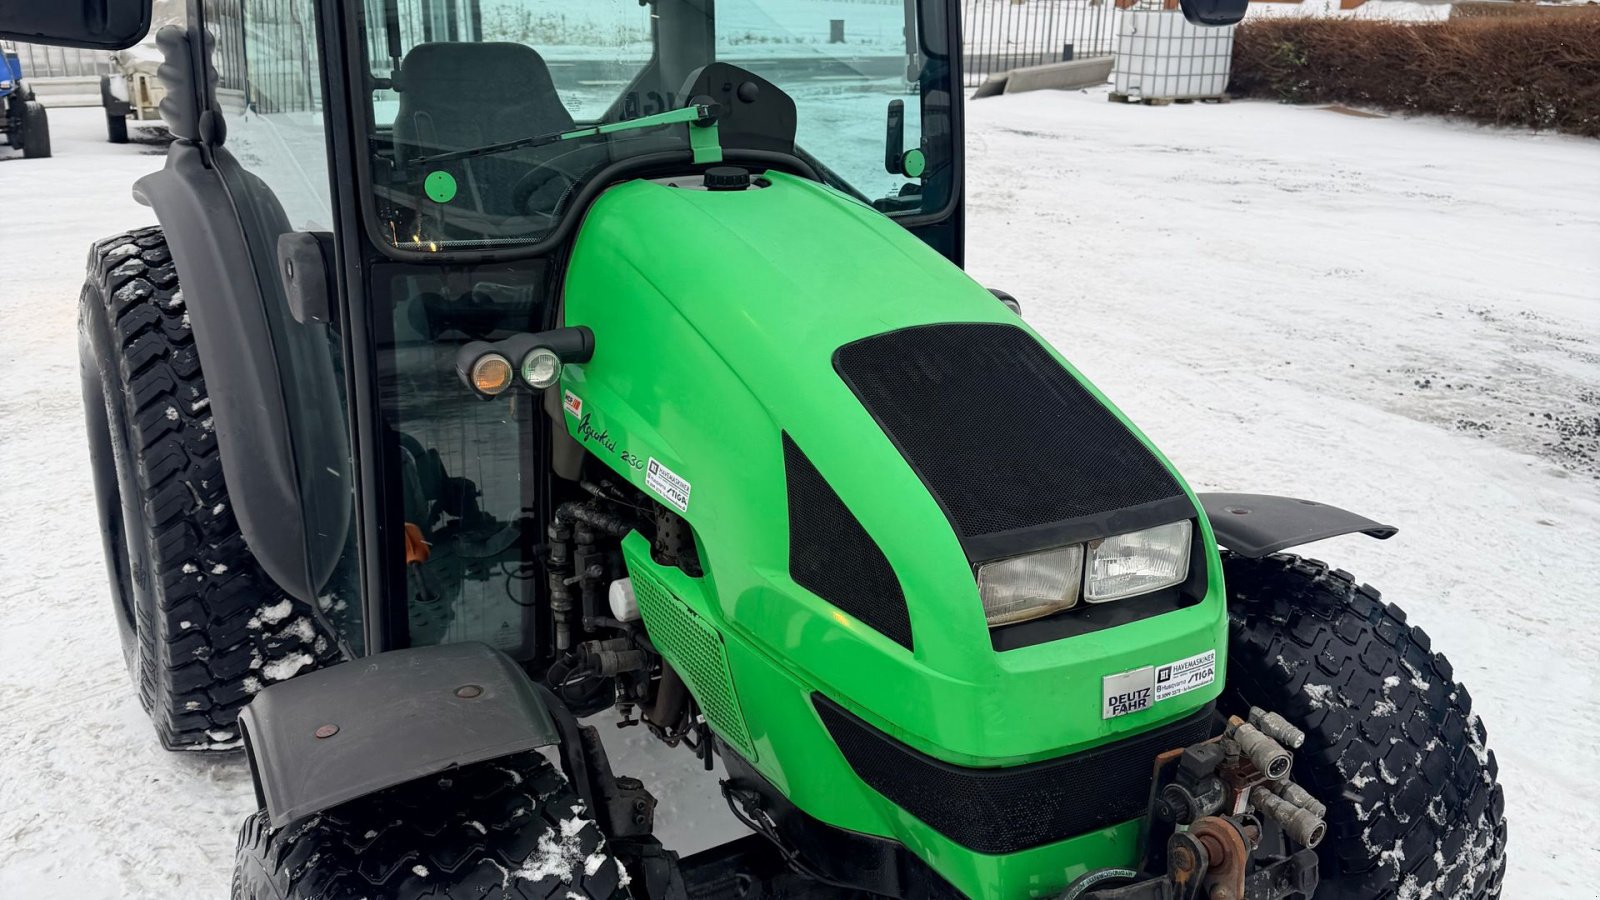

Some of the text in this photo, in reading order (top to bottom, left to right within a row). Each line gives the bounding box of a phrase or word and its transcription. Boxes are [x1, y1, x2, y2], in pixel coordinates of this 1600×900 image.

[620, 450, 644, 470] 230
[1173, 653, 1214, 672] HAVEMASKINER
[1187, 667, 1214, 684] STIGA
[1108, 687, 1151, 707] DEUTZ
[1112, 698, 1147, 716] FAHR
